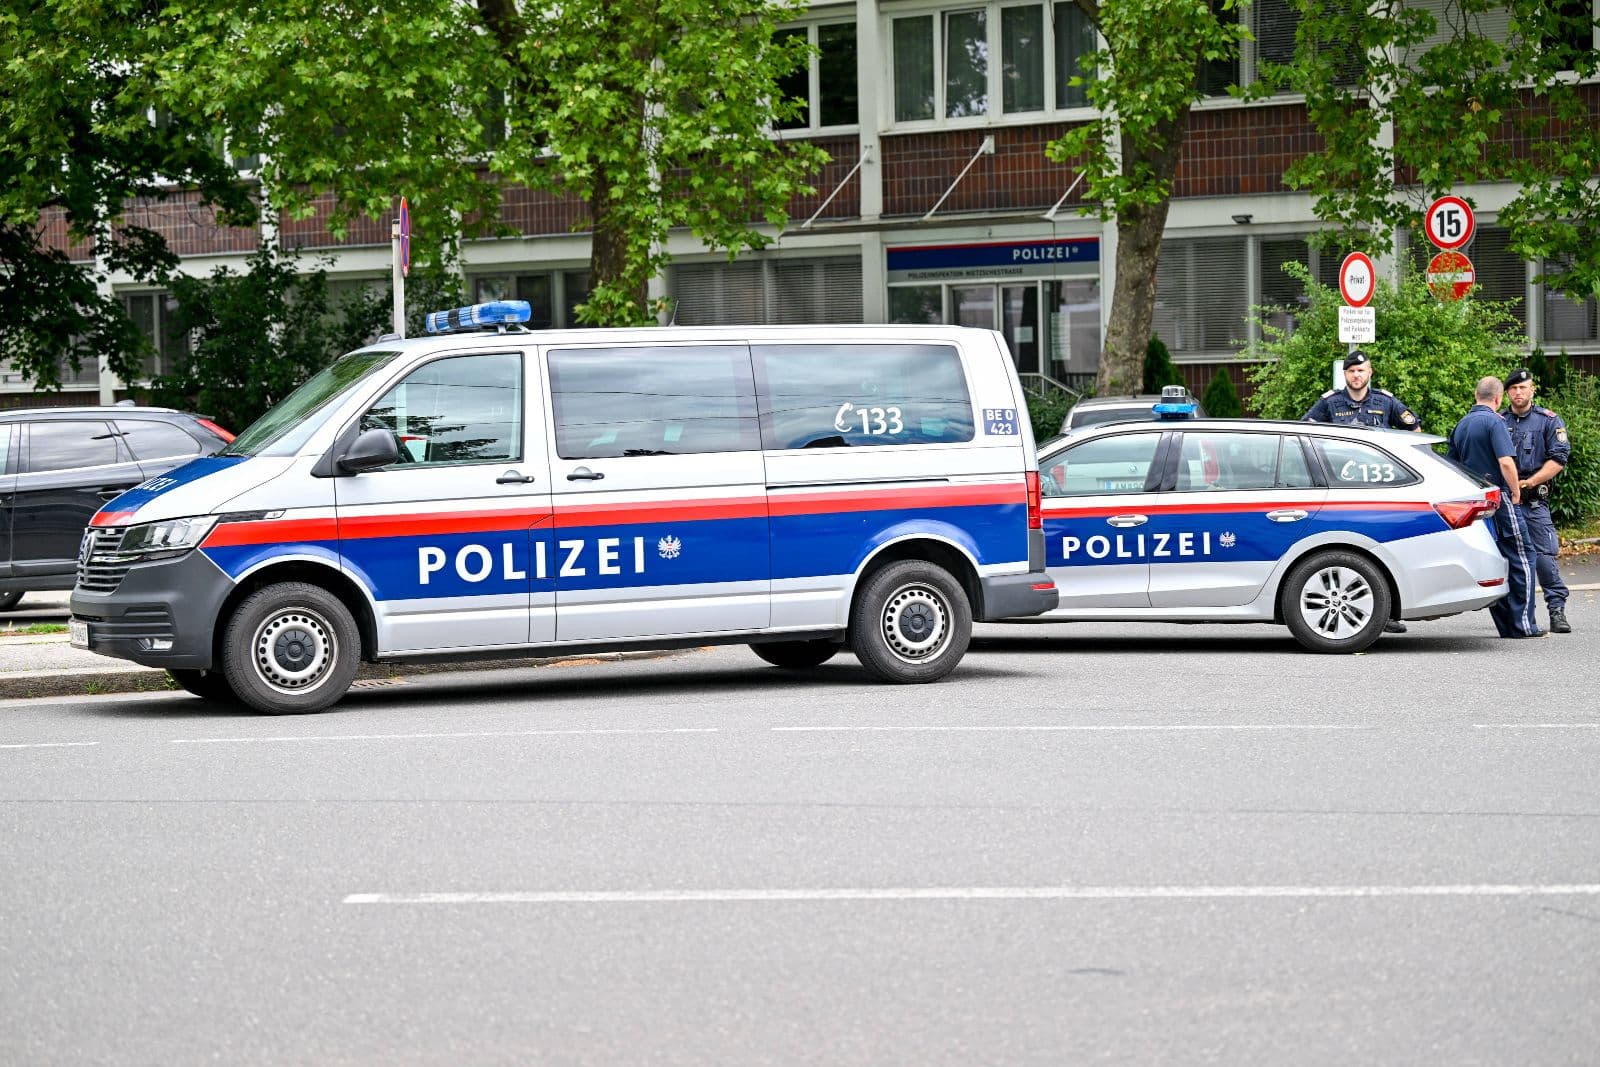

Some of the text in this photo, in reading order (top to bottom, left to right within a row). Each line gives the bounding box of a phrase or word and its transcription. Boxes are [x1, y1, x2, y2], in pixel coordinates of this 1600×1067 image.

[1436, 209, 1461, 238] 15
[1013, 247, 1070, 260] POLIZEI
[1350, 275, 1365, 284] Privat
[856, 406, 903, 435] 133
[986, 409, 1003, 421] BE
[990, 423, 1013, 435] 423
[1358, 463, 1395, 483] 133
[1062, 531, 1211, 560] POLIZEI
[418, 536, 645, 585] POLIZEI
